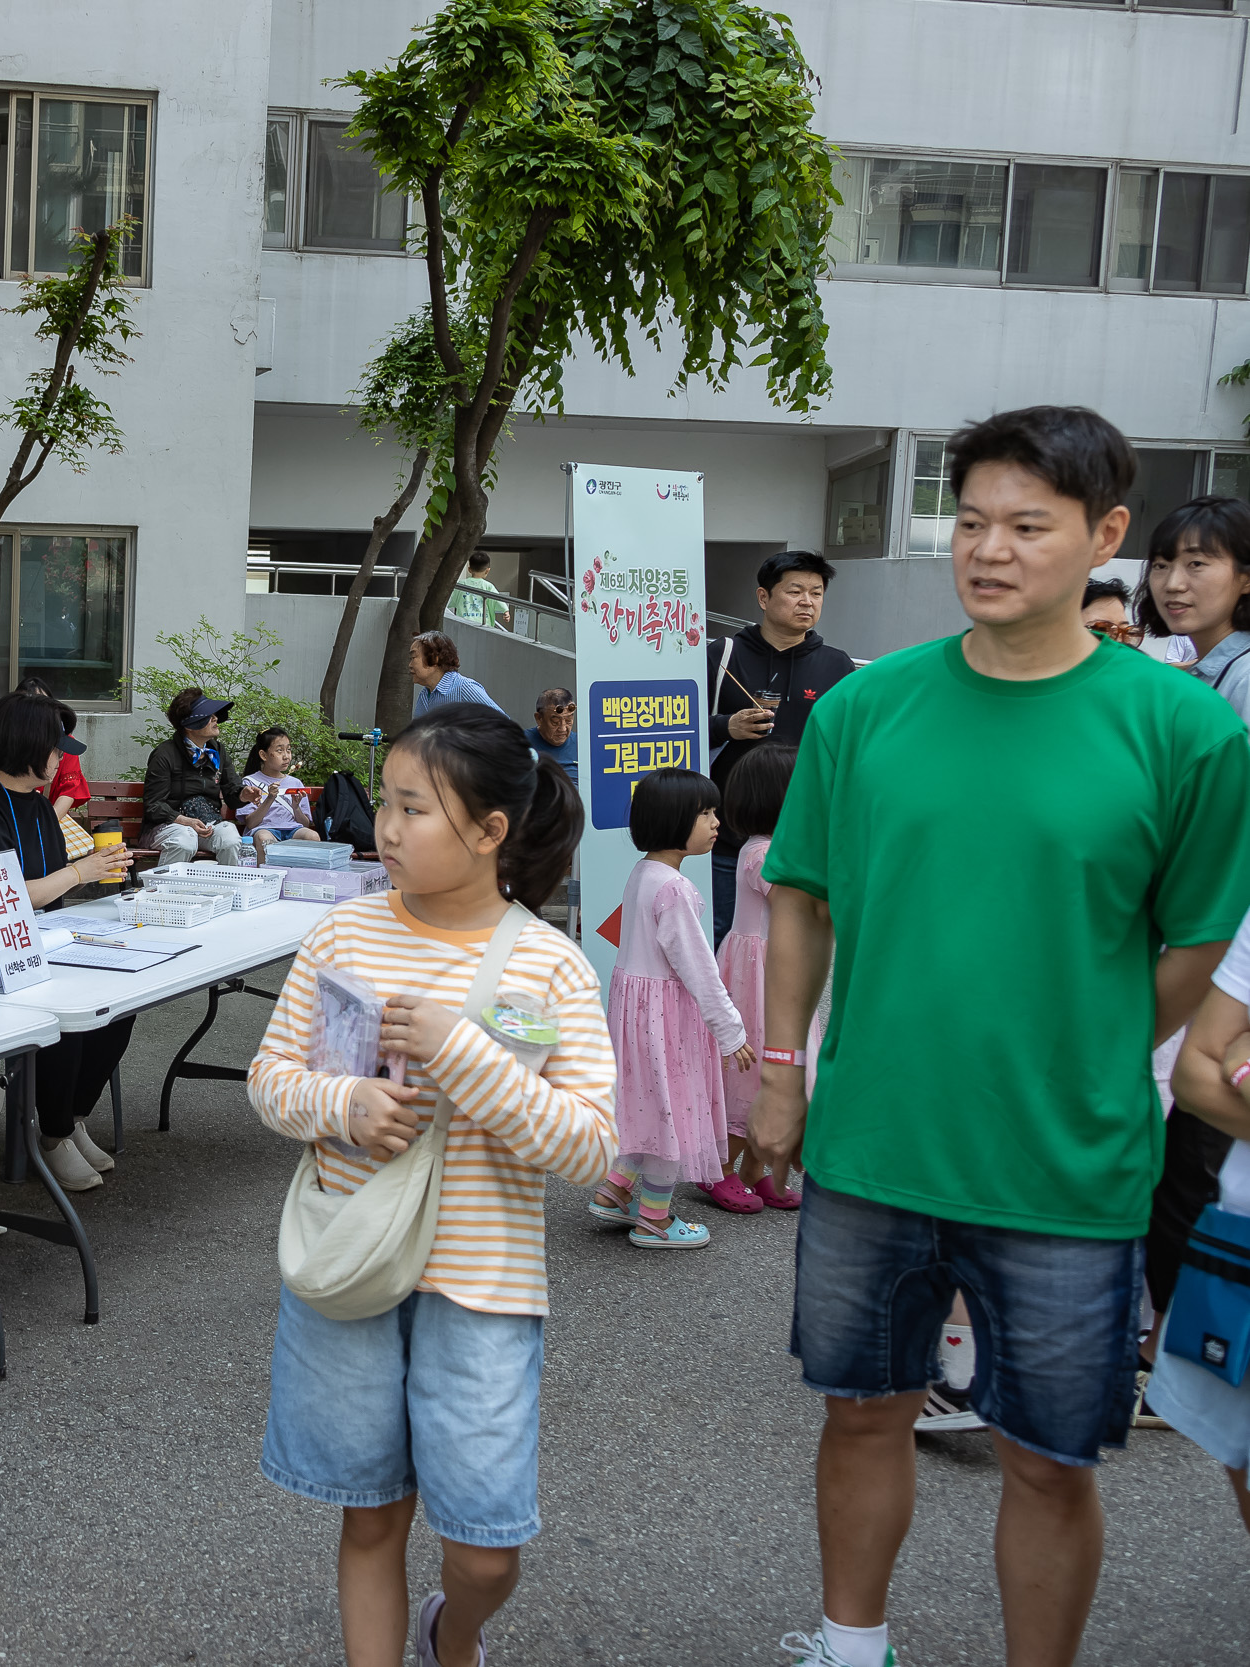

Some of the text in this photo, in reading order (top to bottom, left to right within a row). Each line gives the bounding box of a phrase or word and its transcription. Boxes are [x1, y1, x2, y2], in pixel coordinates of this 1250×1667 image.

[598, 480, 622, 491] 광진구
[599, 567, 688, 596] 제6회 자양3동
[599, 595, 687, 652] 장미축제
[602, 694, 690, 729] 백일장대회
[603, 739, 691, 774] 그림그리기
[0, 919, 32, 952] 마감
[4, 959, 26, 977] (선착순
[26, 954, 42, 970] 마감)
